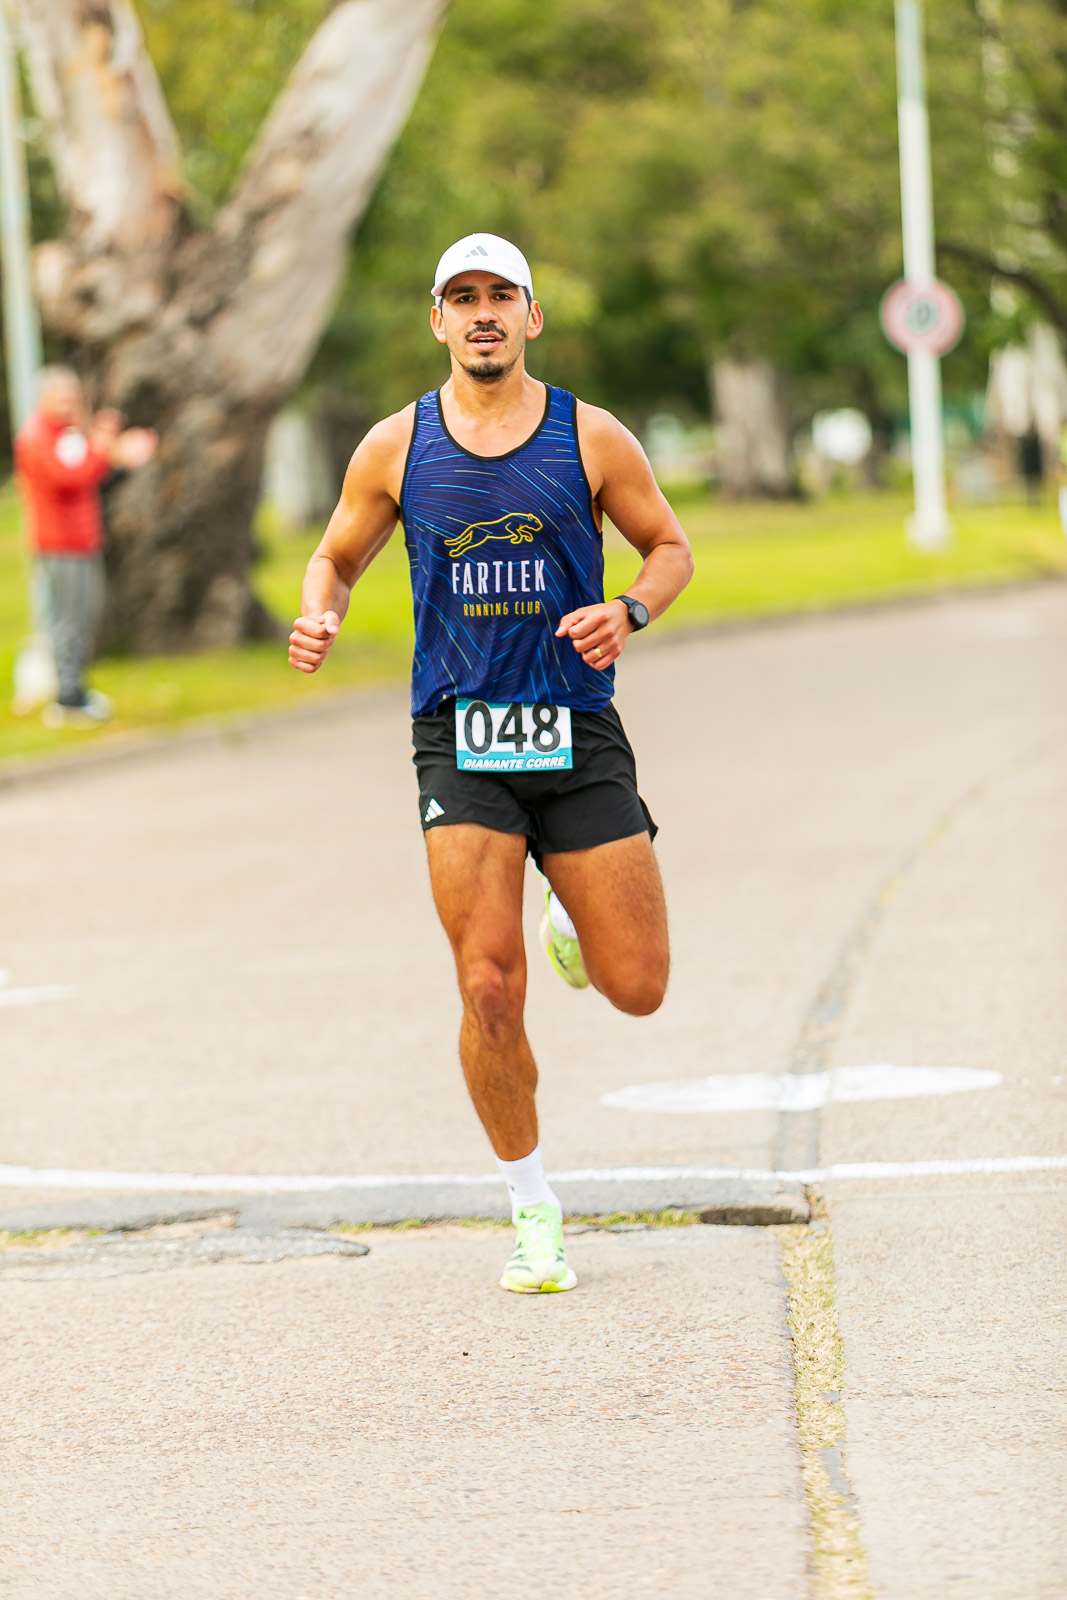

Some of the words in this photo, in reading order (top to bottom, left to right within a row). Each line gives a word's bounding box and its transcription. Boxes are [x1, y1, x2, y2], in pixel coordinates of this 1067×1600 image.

[452, 559, 546, 594] FARTLEK
[463, 602, 509, 617] RUNNING
[514, 600, 541, 615] CLUB
[464, 701, 561, 754] 048
[463, 757, 524, 770] DIAMANTE
[526, 756, 566, 769] CORRE
